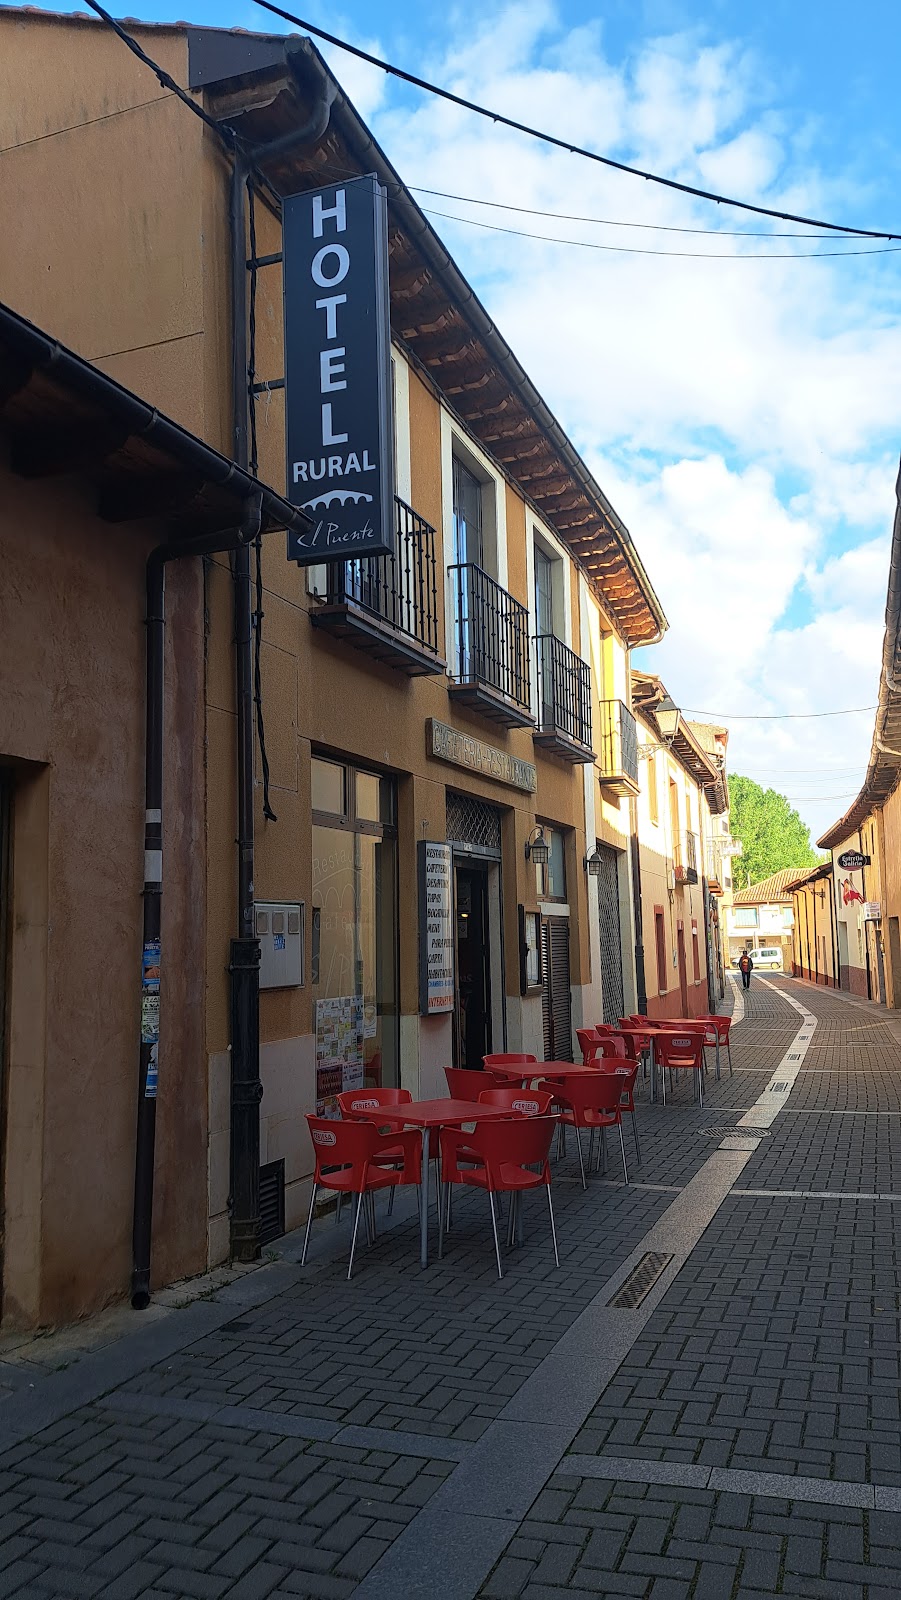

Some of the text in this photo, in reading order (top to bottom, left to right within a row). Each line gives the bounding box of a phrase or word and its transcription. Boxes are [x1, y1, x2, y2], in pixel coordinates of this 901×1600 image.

[311, 188, 350, 447] HOTEL
[293, 449, 376, 483] RURAL
[326, 518, 375, 547] Puente
